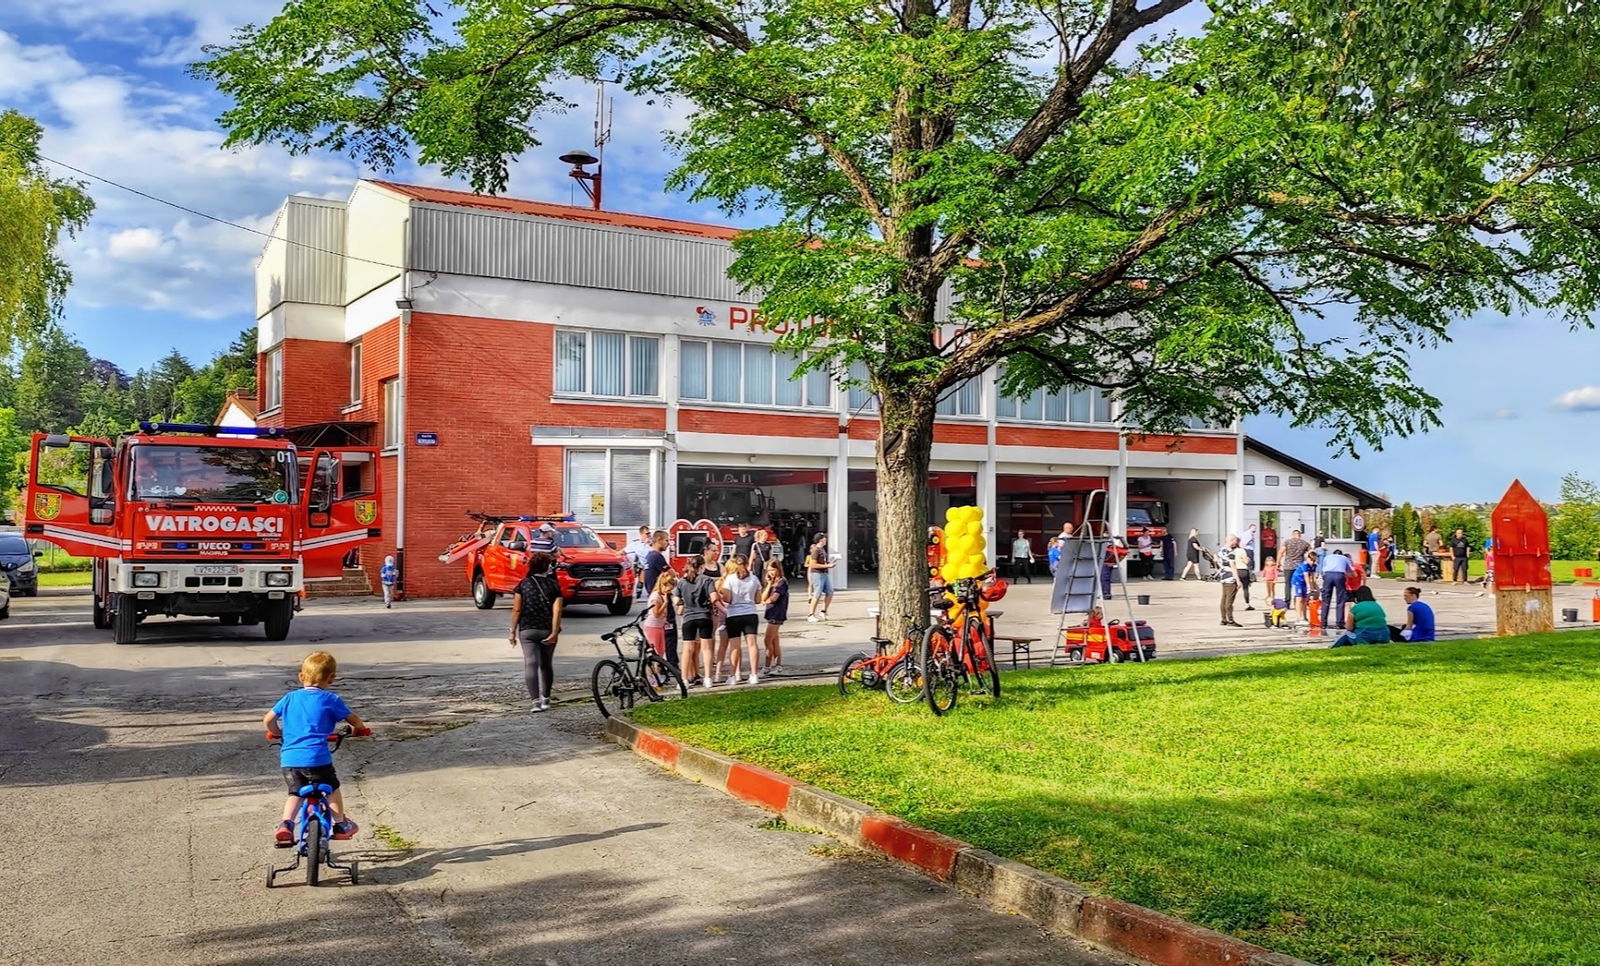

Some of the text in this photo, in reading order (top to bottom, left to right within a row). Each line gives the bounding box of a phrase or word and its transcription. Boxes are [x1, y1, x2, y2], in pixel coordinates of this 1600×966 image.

[276, 450, 291, 463] 01
[145, 514, 284, 533] VATROGASCI
[198, 542, 232, 551] IVECO
